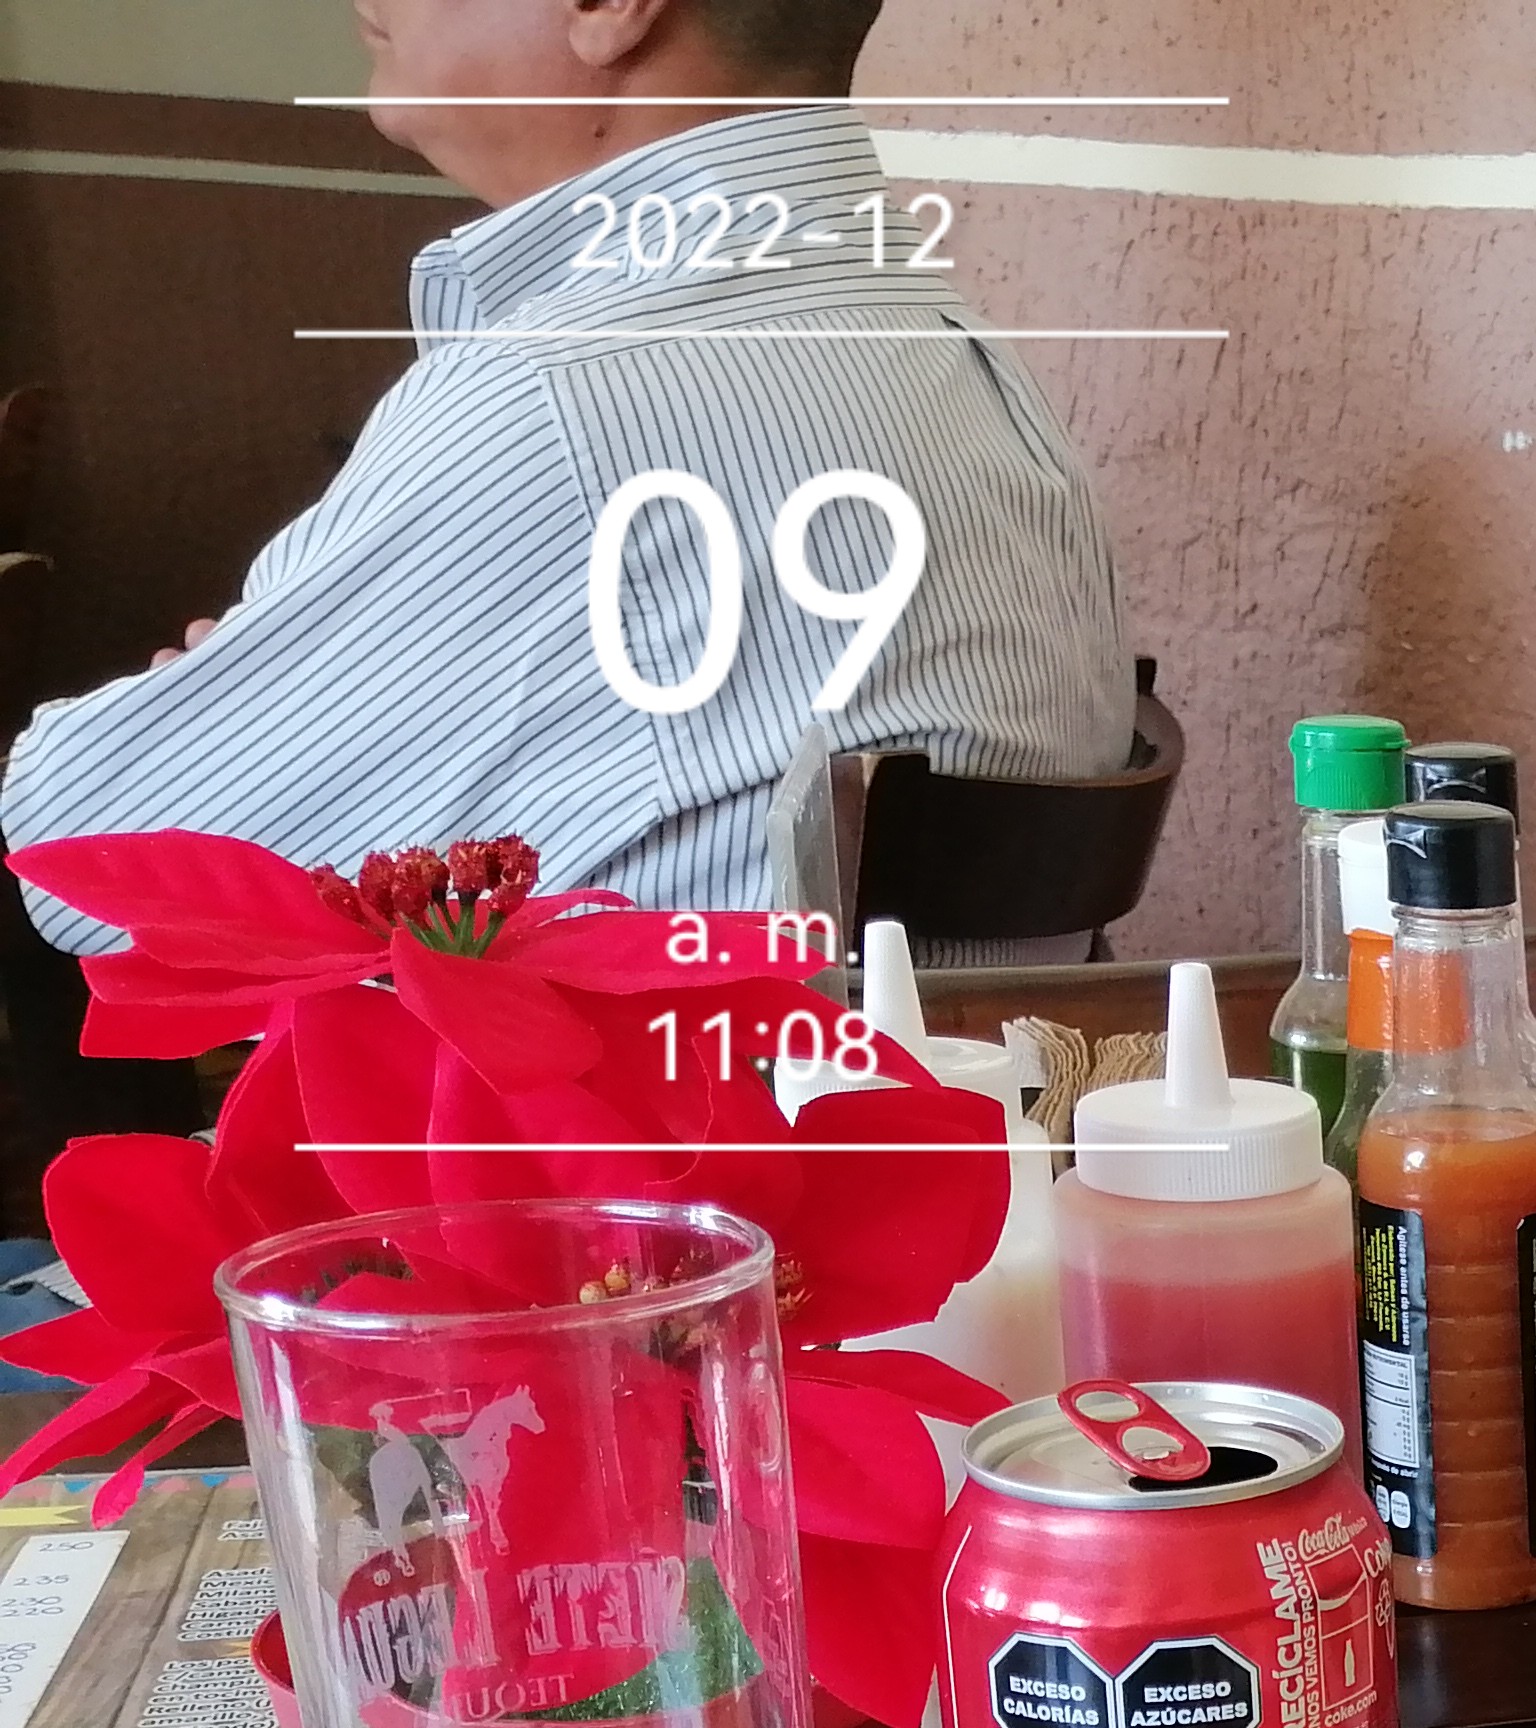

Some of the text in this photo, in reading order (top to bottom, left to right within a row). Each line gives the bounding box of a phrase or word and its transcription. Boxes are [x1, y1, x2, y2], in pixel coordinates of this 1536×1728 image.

[1302, 1624, 1319, 1692] VEMOS
[1009, 1676, 1086, 1701] EXCESO
[1144, 1681, 1232, 1703] EXCESO
[1003, 1698, 1099, 1726] CALORÍAS
[1130, 1702, 1249, 1728] AZÚCARES
[1324, 1689, 1377, 1728] coke.com
